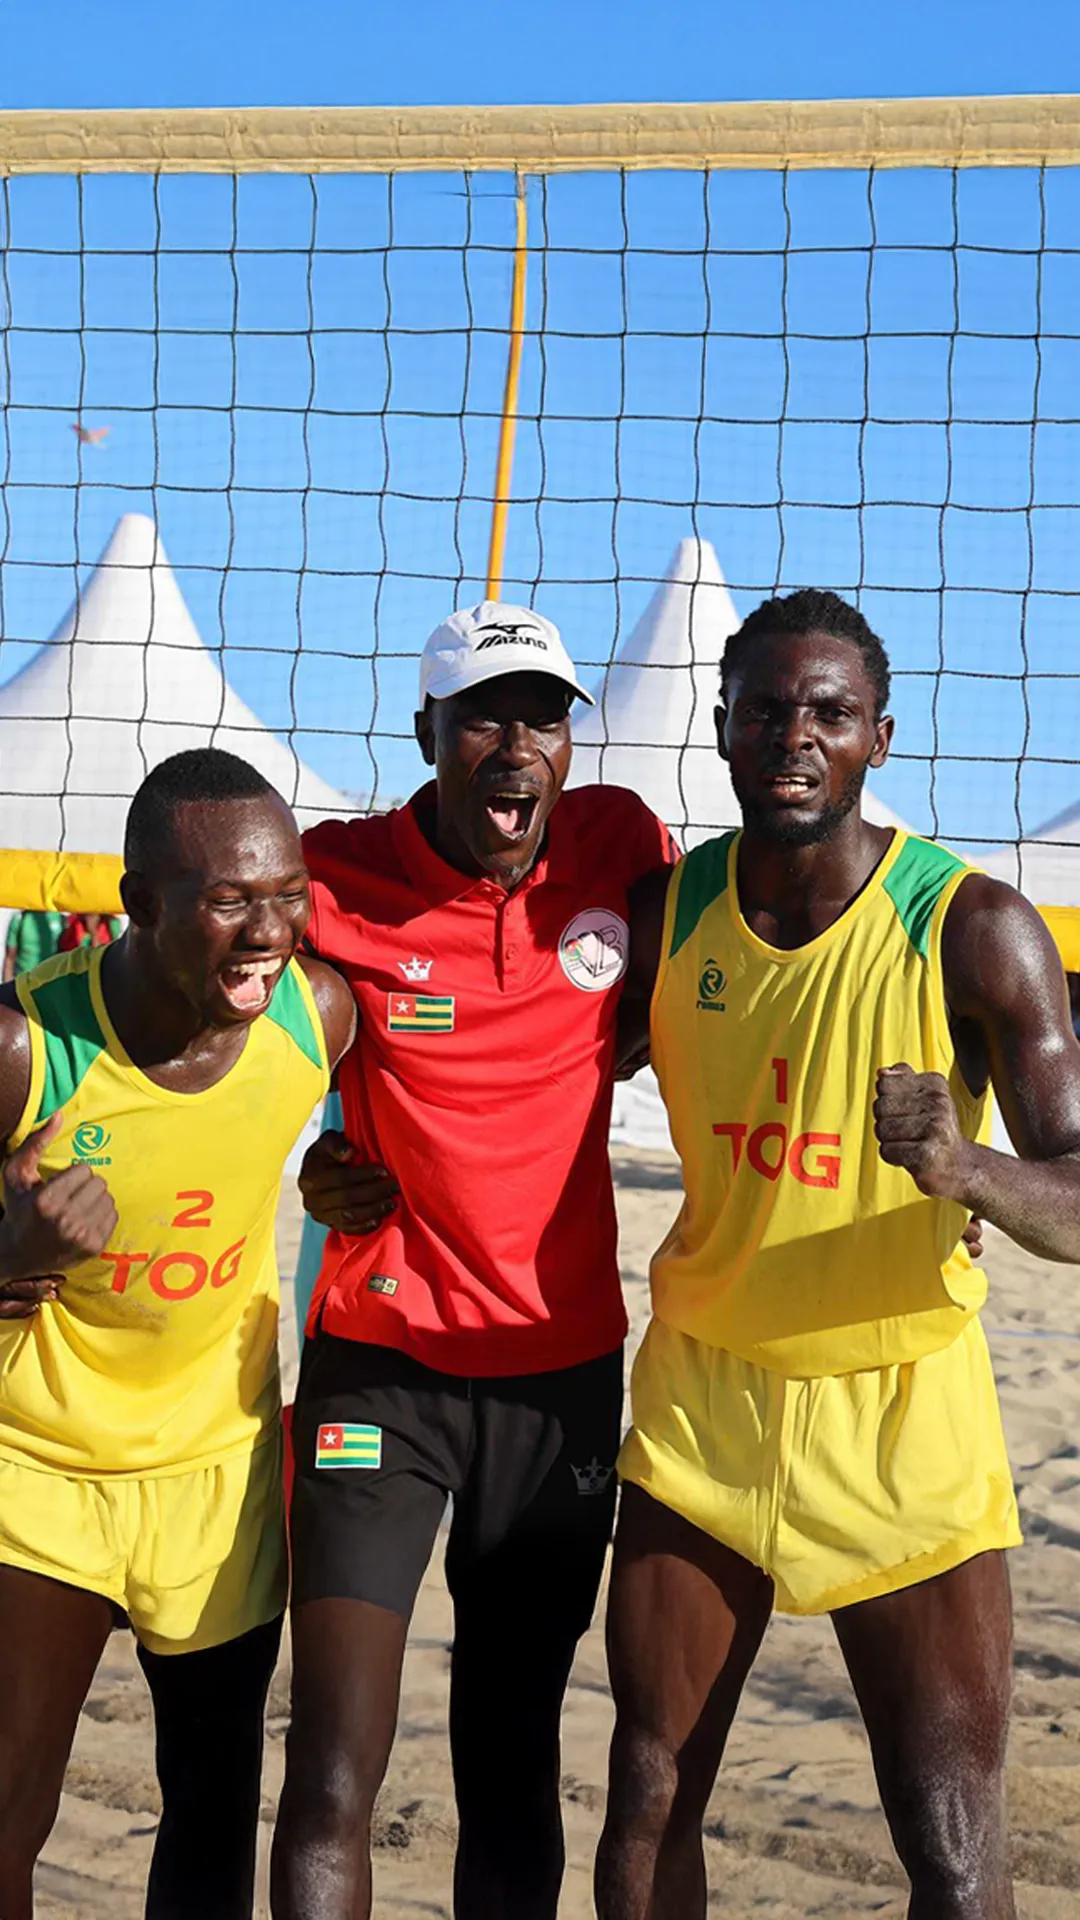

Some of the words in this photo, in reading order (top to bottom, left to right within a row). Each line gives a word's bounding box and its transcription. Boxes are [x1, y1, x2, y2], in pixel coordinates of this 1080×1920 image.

[772, 1057, 788, 1104] 1
[712, 1122, 842, 1190] TOG
[171, 1189, 215, 1228] 2
[100, 1234, 248, 1302] TOG
